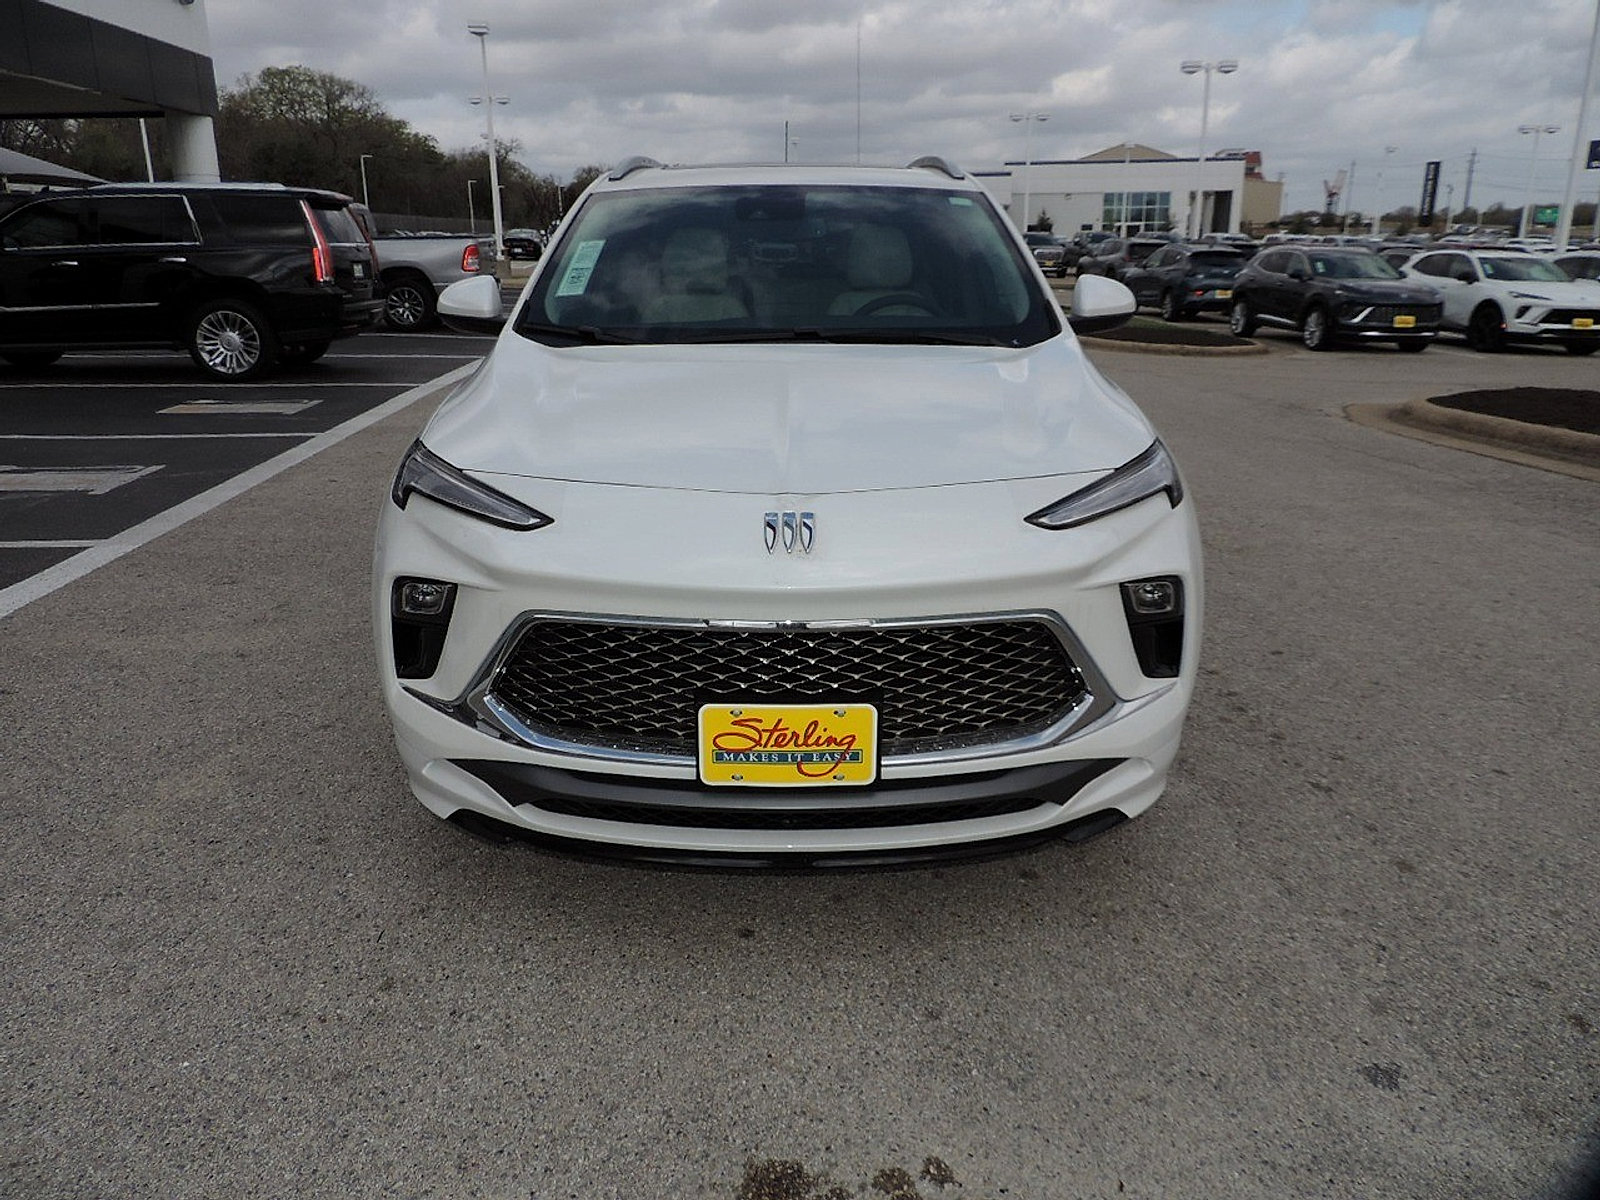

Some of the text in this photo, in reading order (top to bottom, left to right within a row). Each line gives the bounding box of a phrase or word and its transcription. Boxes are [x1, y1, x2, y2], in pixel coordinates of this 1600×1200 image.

[712, 717, 857, 778] Sterling
[722, 751, 852, 762] MAKES IT EASY
